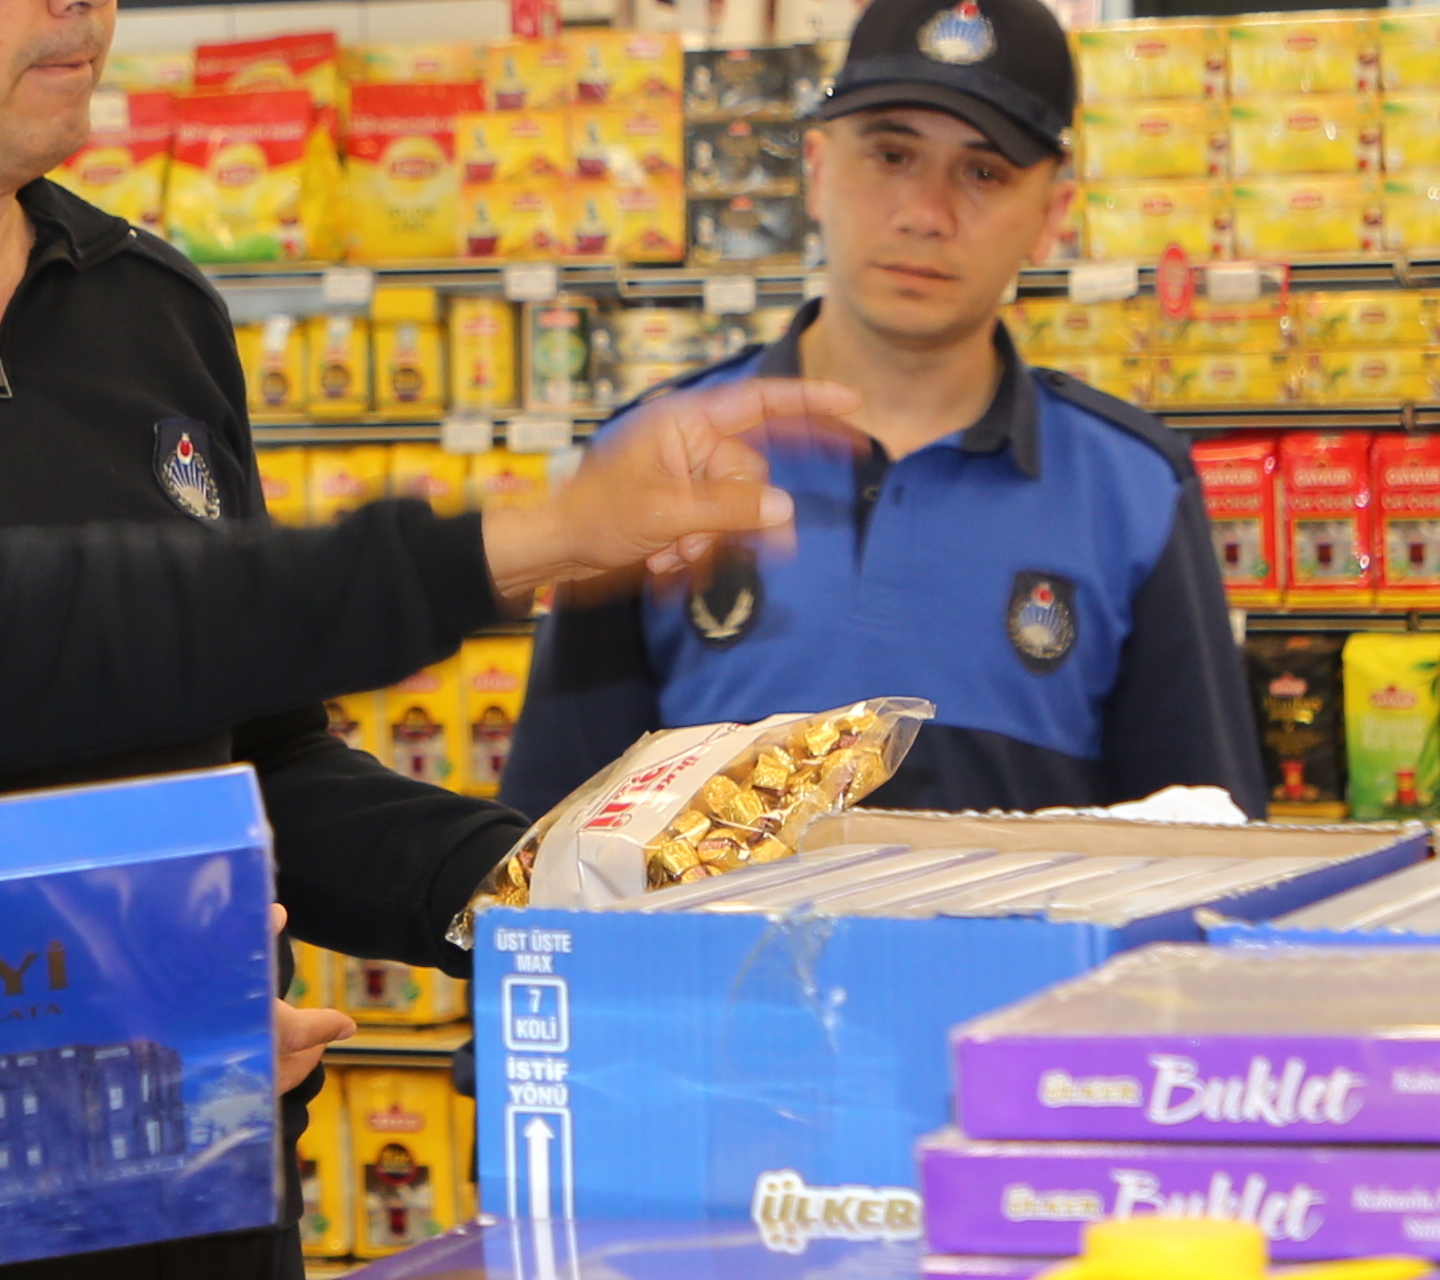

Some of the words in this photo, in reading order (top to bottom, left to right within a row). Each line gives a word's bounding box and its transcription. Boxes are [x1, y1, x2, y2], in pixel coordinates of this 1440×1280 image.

[495, 929, 527, 951] ÜST
[531, 929, 572, 953] ÜSTE
[516, 954, 554, 973] MAX
[529, 989, 542, 1014] 7
[516, 1016, 558, 1040] KOLİ
[507, 1057, 568, 1081] İSTİF
[508, 1082, 568, 1106] YÖNÜ
[1148, 1053, 1367, 1127] Buklet
[756, 1172, 920, 1228] ÜLKER
